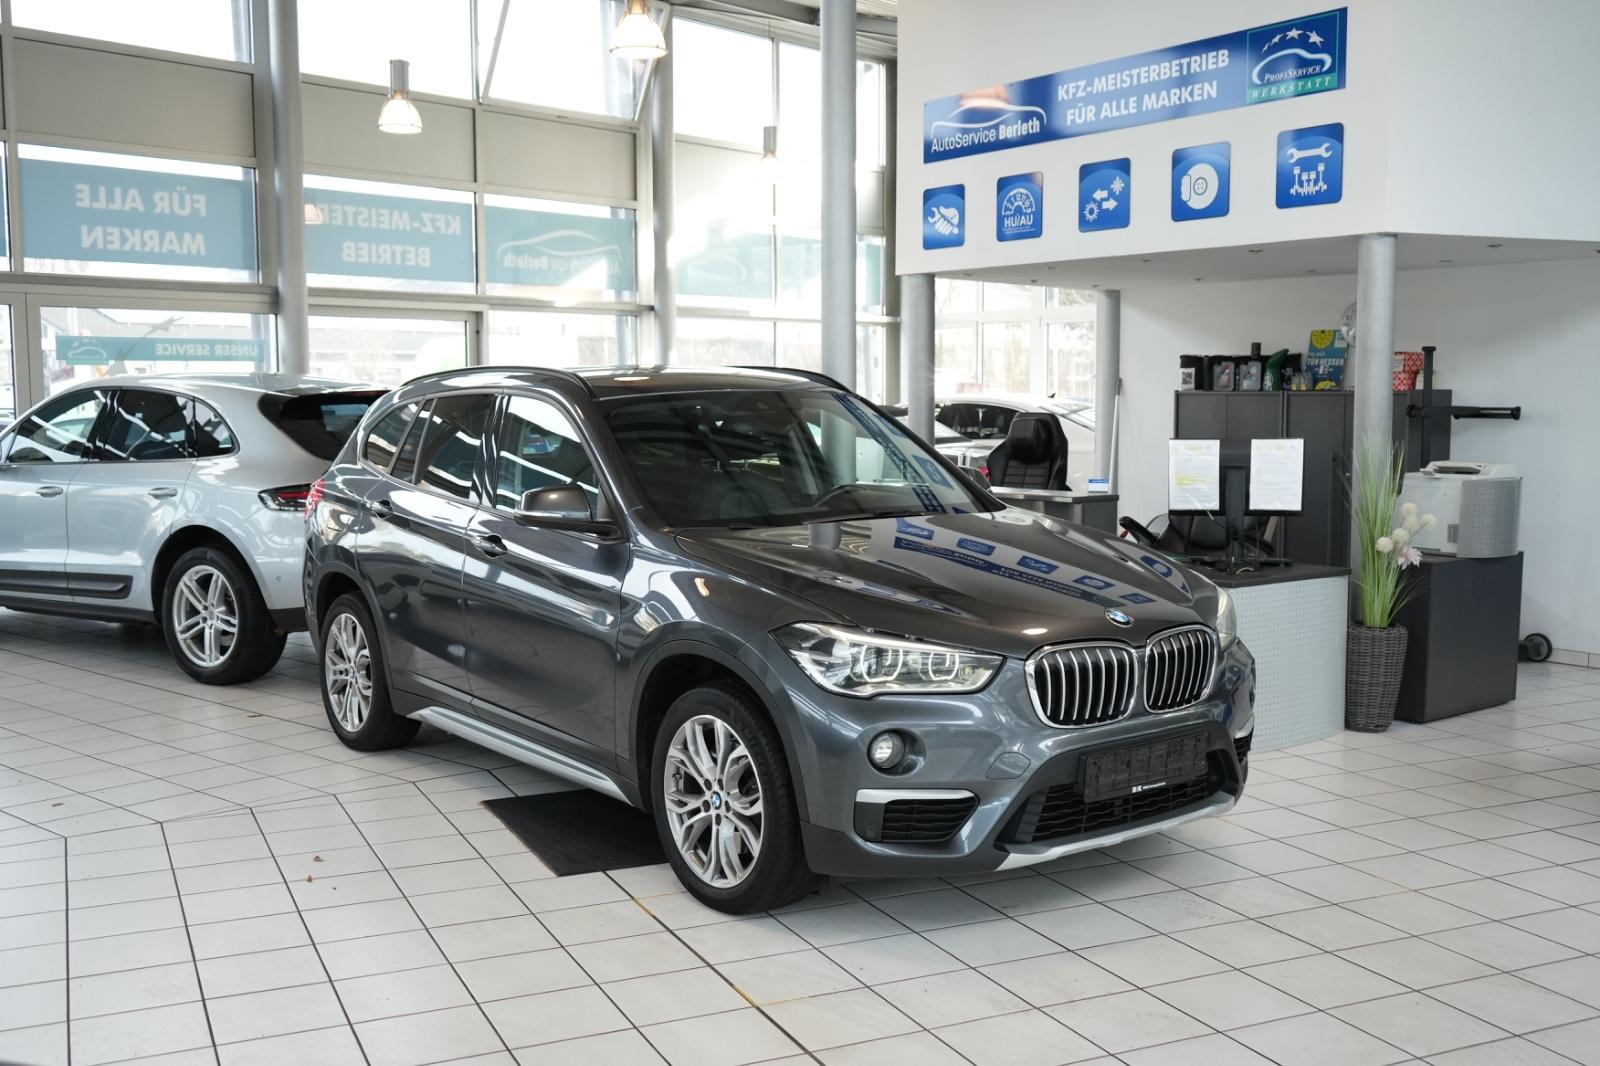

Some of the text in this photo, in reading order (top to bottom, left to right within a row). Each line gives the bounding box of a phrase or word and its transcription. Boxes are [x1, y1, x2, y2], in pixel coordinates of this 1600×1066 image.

[1057, 49, 1229, 101] KFZ-MEISTERBETRIEB
[1252, 76, 1331, 98] WERKSTATT
[1066, 80, 1218, 126] FÜR ALLE MARKEN
[931, 116, 1040, 153] AutoService Berleth
[1004, 213, 1033, 228] HU/AU
